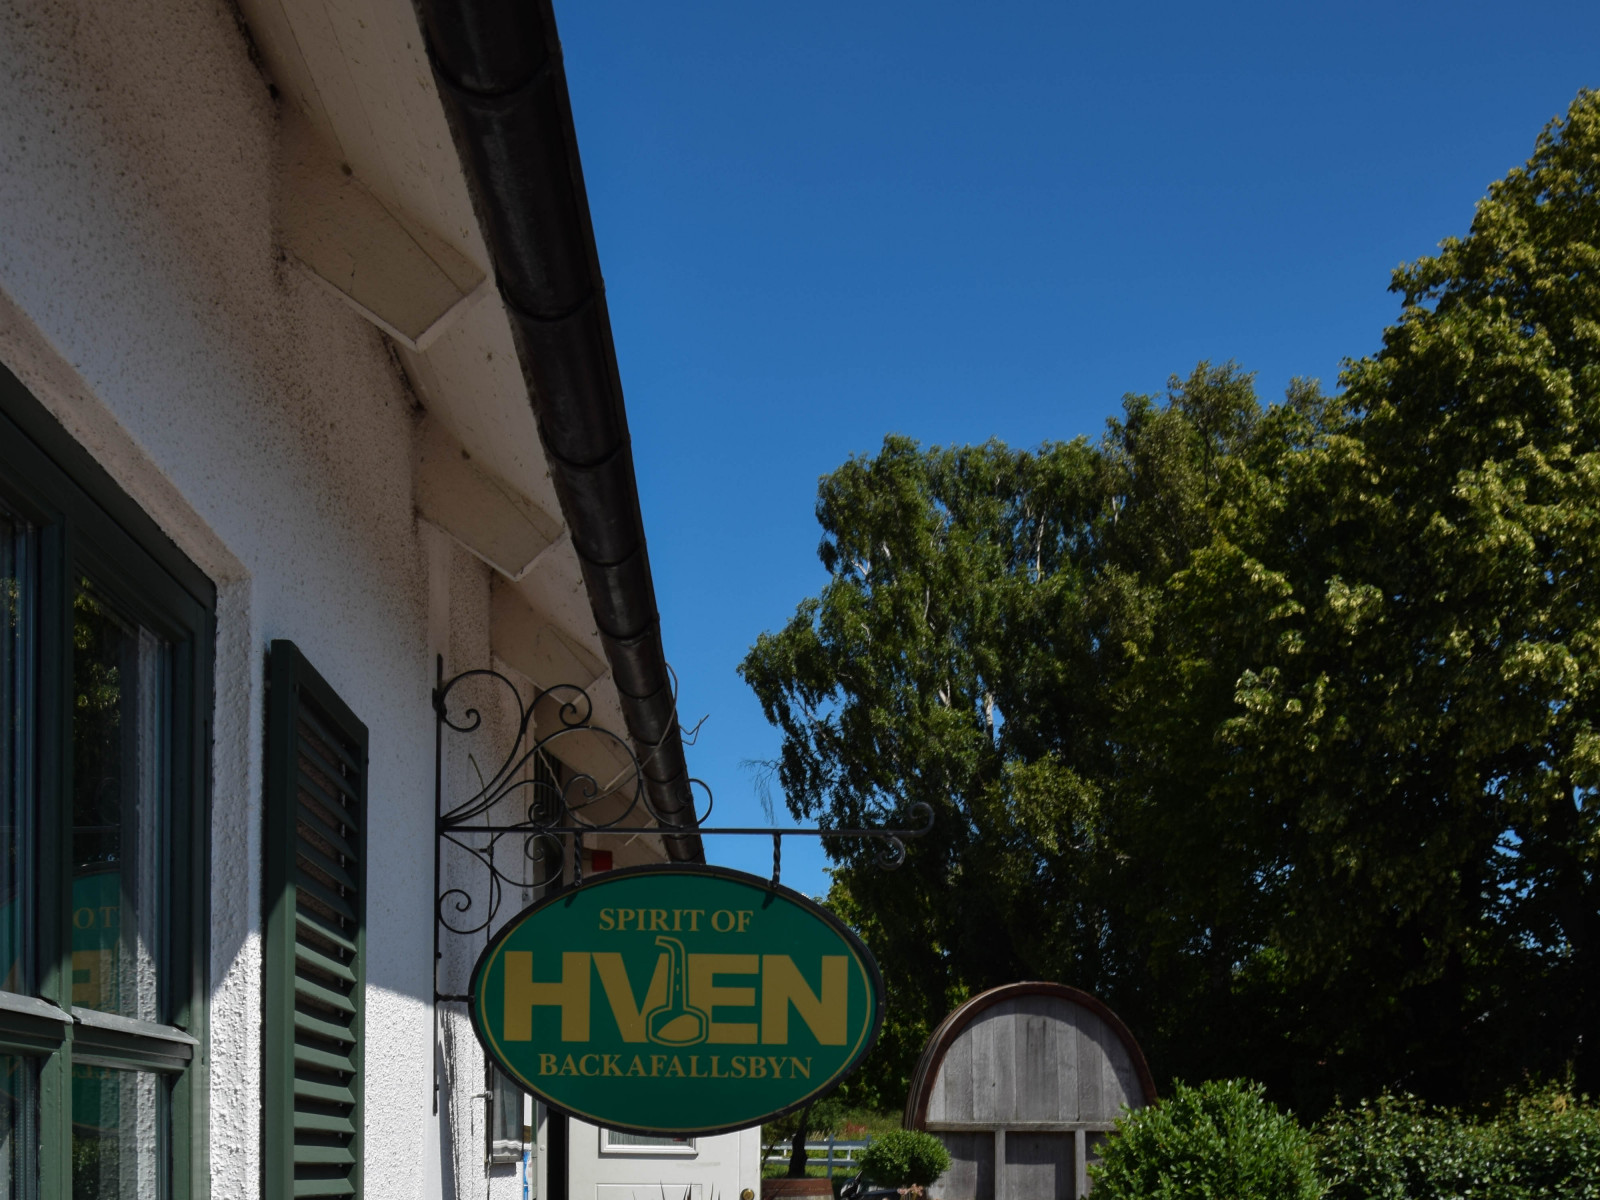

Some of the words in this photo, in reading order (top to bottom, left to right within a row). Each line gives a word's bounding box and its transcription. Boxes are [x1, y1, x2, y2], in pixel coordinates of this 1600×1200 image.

[598, 907, 705, 932] SPIRIT
[711, 909, 754, 933] OF
[503, 950, 849, 1046] HVEN
[537, 1052, 813, 1080] BACKAFALLSBYN
